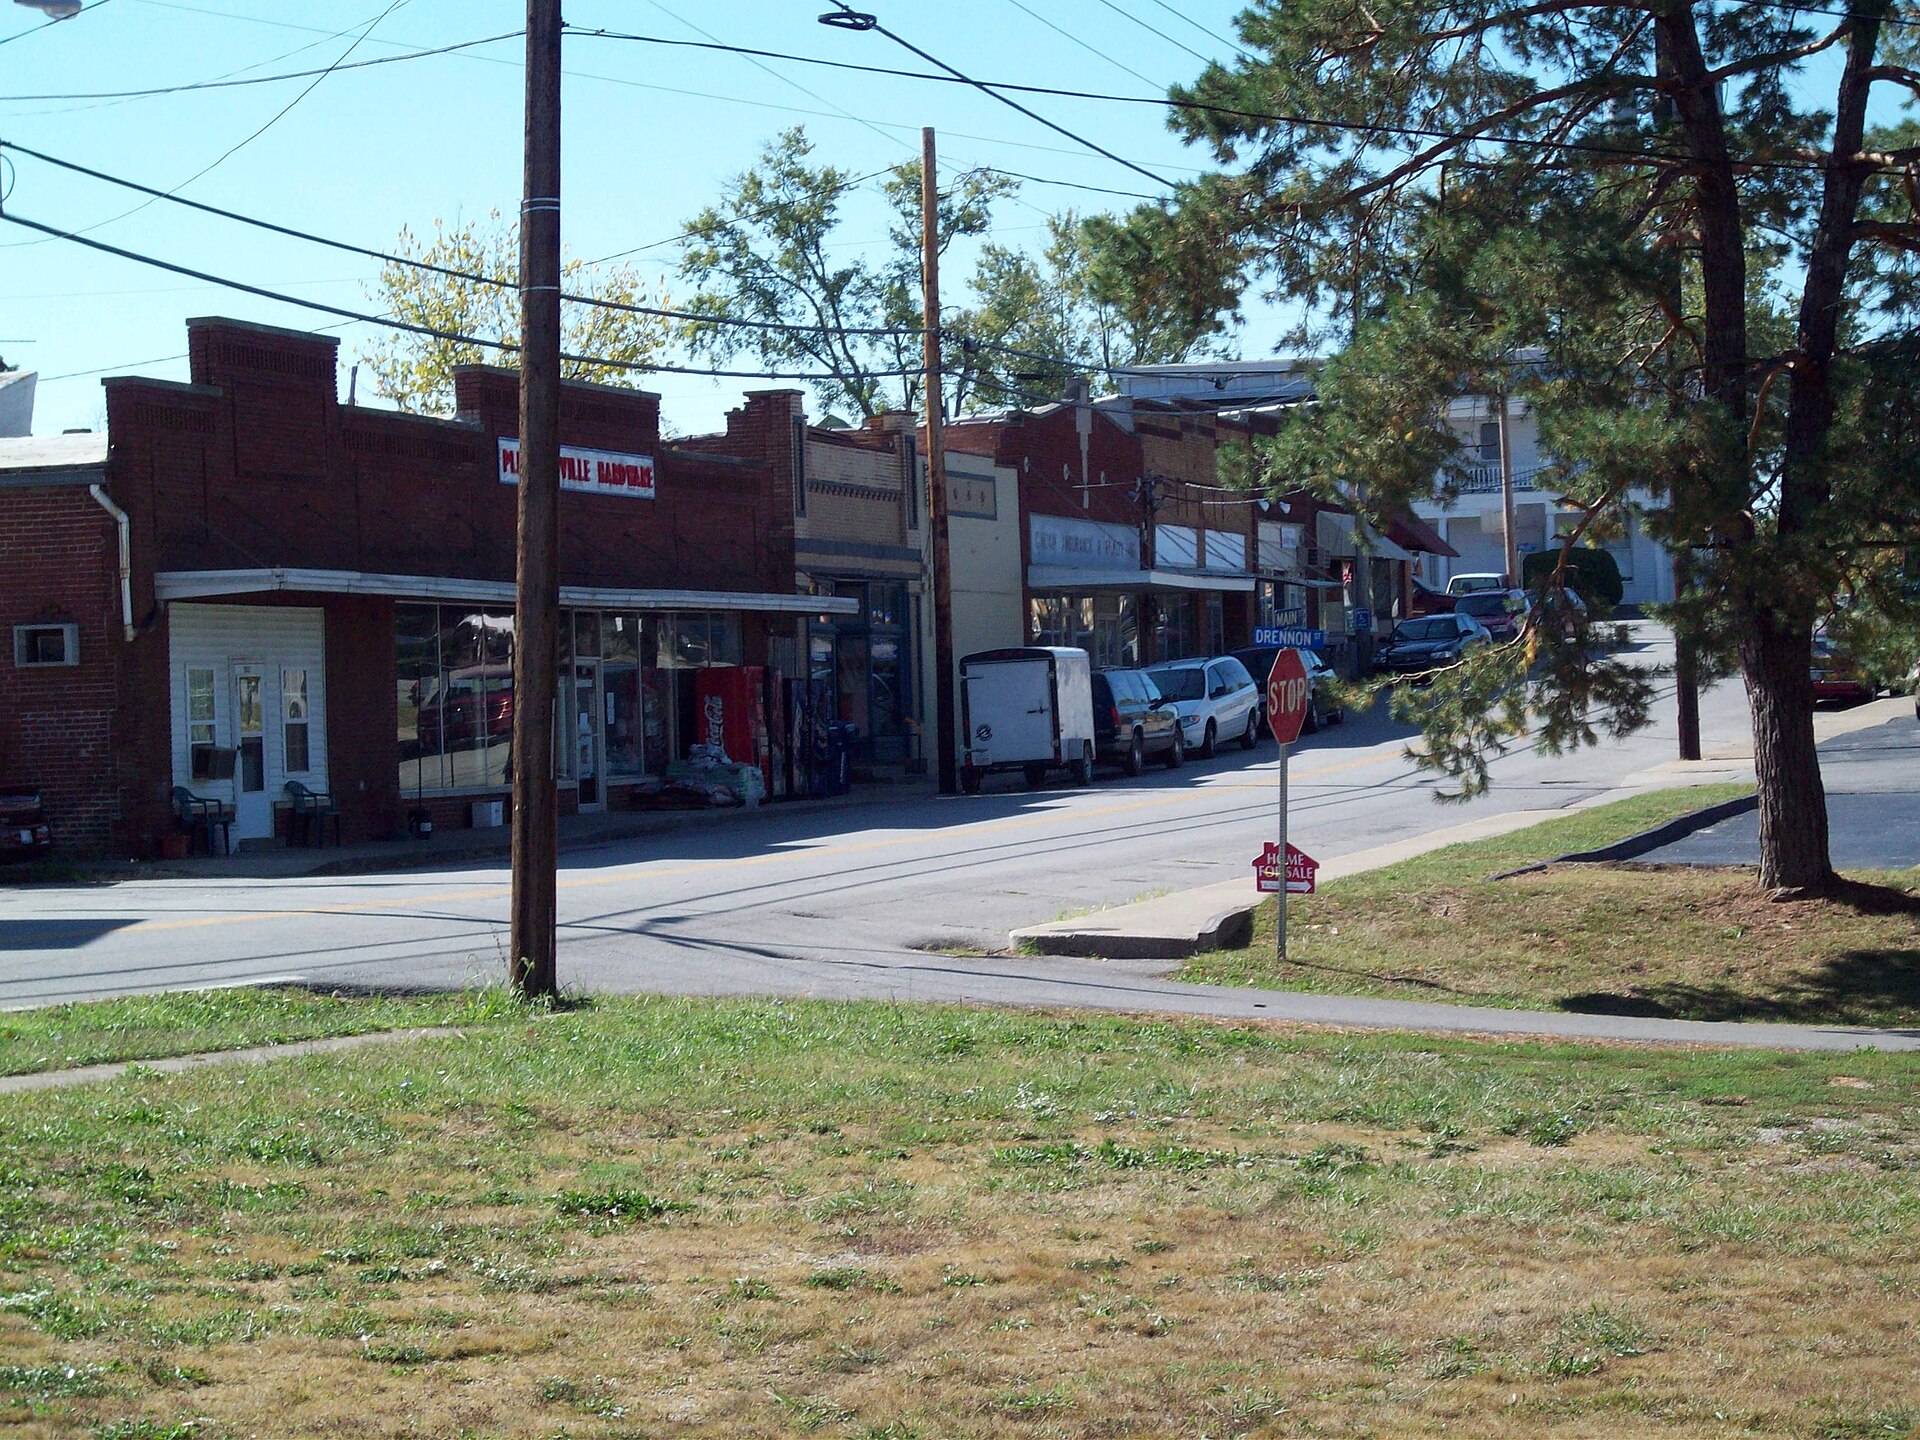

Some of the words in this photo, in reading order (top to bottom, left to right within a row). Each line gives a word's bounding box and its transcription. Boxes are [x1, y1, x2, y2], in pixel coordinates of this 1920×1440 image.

[1276, 611, 1297, 626] MAIN
[1255, 629, 1312, 646] DRENNON
[1313, 632, 1321, 640] ST
[1270, 677, 1305, 715] STOP
[1286, 867, 1313, 879] SALE
